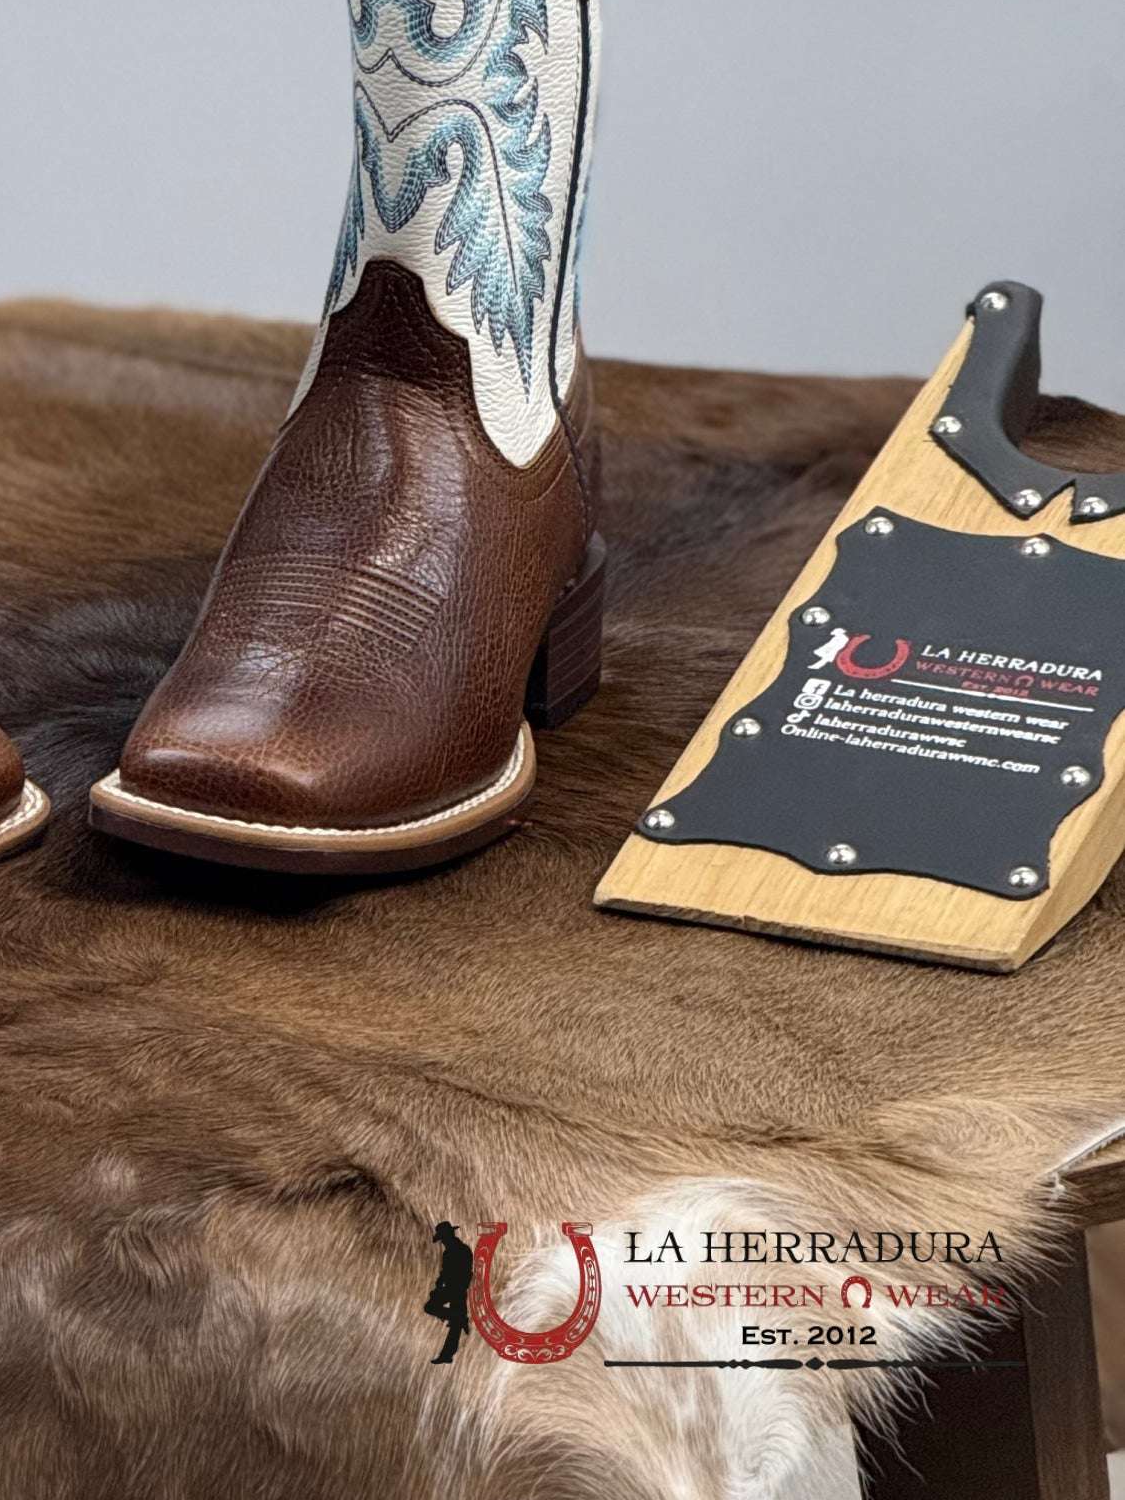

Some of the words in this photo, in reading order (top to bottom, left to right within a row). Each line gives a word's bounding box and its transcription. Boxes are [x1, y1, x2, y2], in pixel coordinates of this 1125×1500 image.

[915, 660, 1012, 684] WESTERN
[1039, 679, 1100, 697] WEAR
[921, 644, 950, 659] LA
[956, 649, 1103, 681] HERRADURA
[833, 684, 856, 697] La
[859, 688, 947, 713] herradura
[952, 705, 1021, 723] western
[1025, 716, 1070, 730] wear
